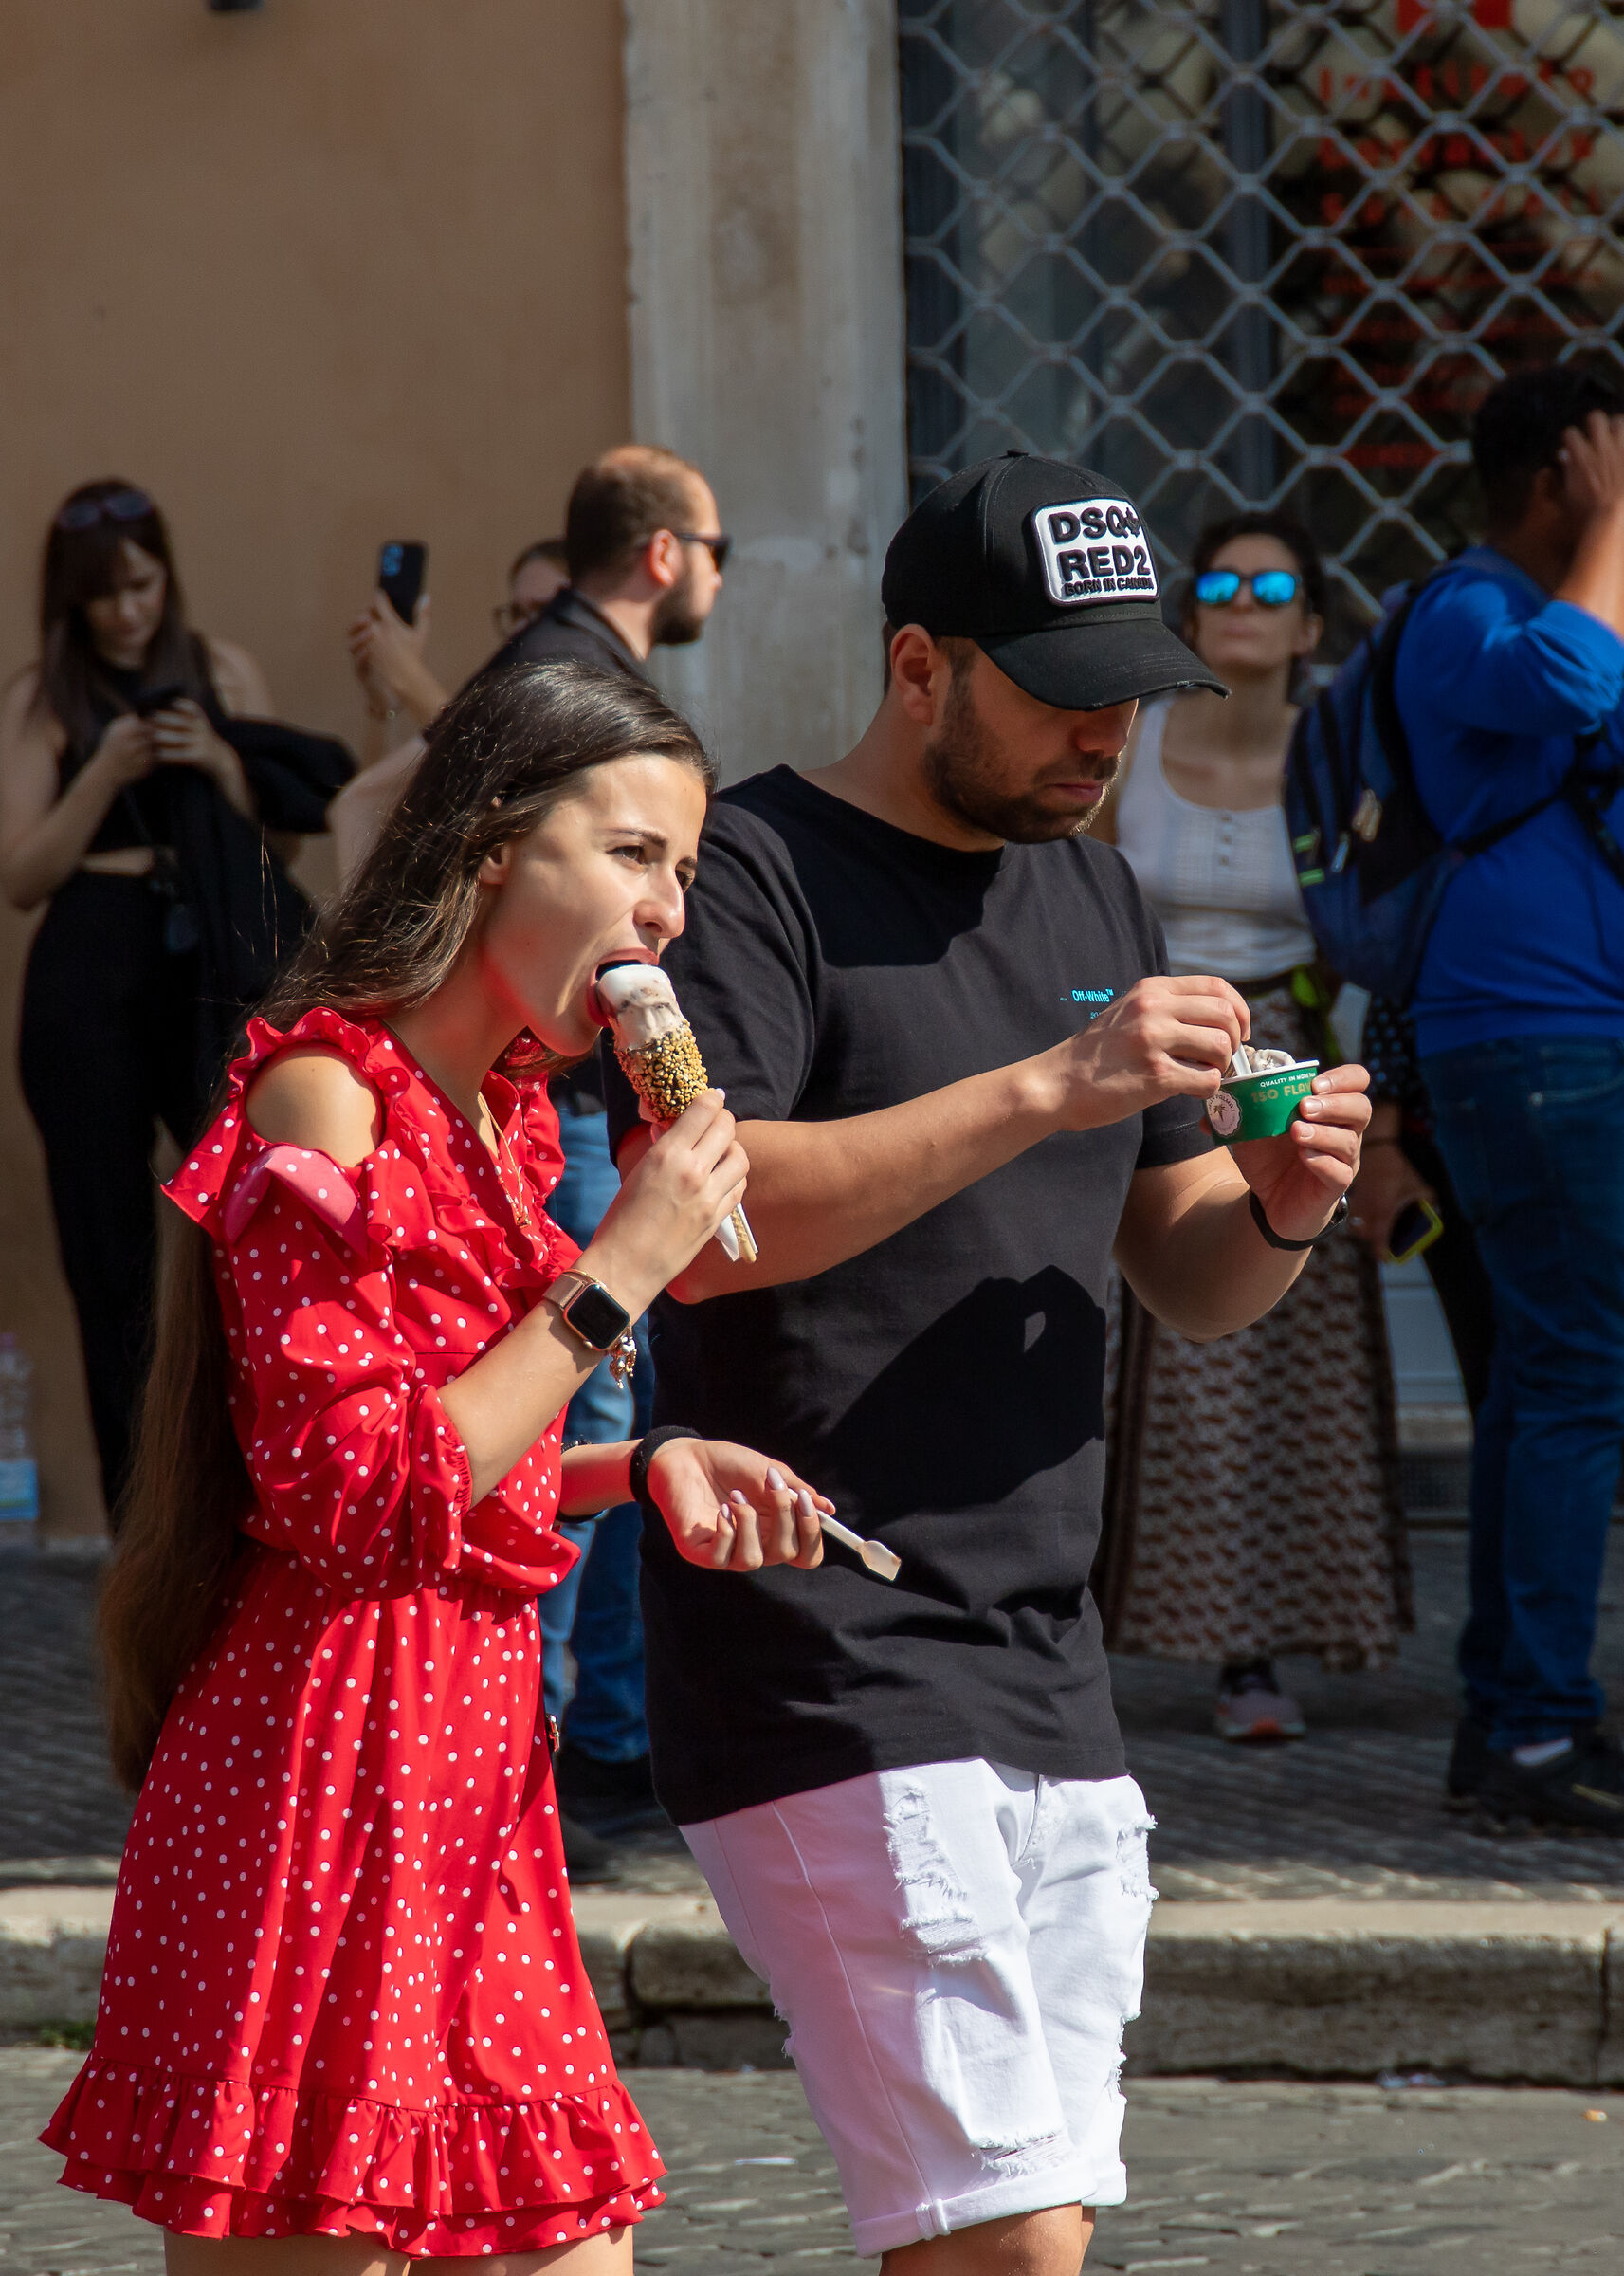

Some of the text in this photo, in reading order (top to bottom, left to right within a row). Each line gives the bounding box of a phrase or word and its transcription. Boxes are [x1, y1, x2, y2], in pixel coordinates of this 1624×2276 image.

[1057, 545, 1151, 581] RED2
[1064, 578, 1102, 596] BORN
[1103, 578, 1116, 592] IN
[1260, 1076, 1287, 1088] QUALITY
